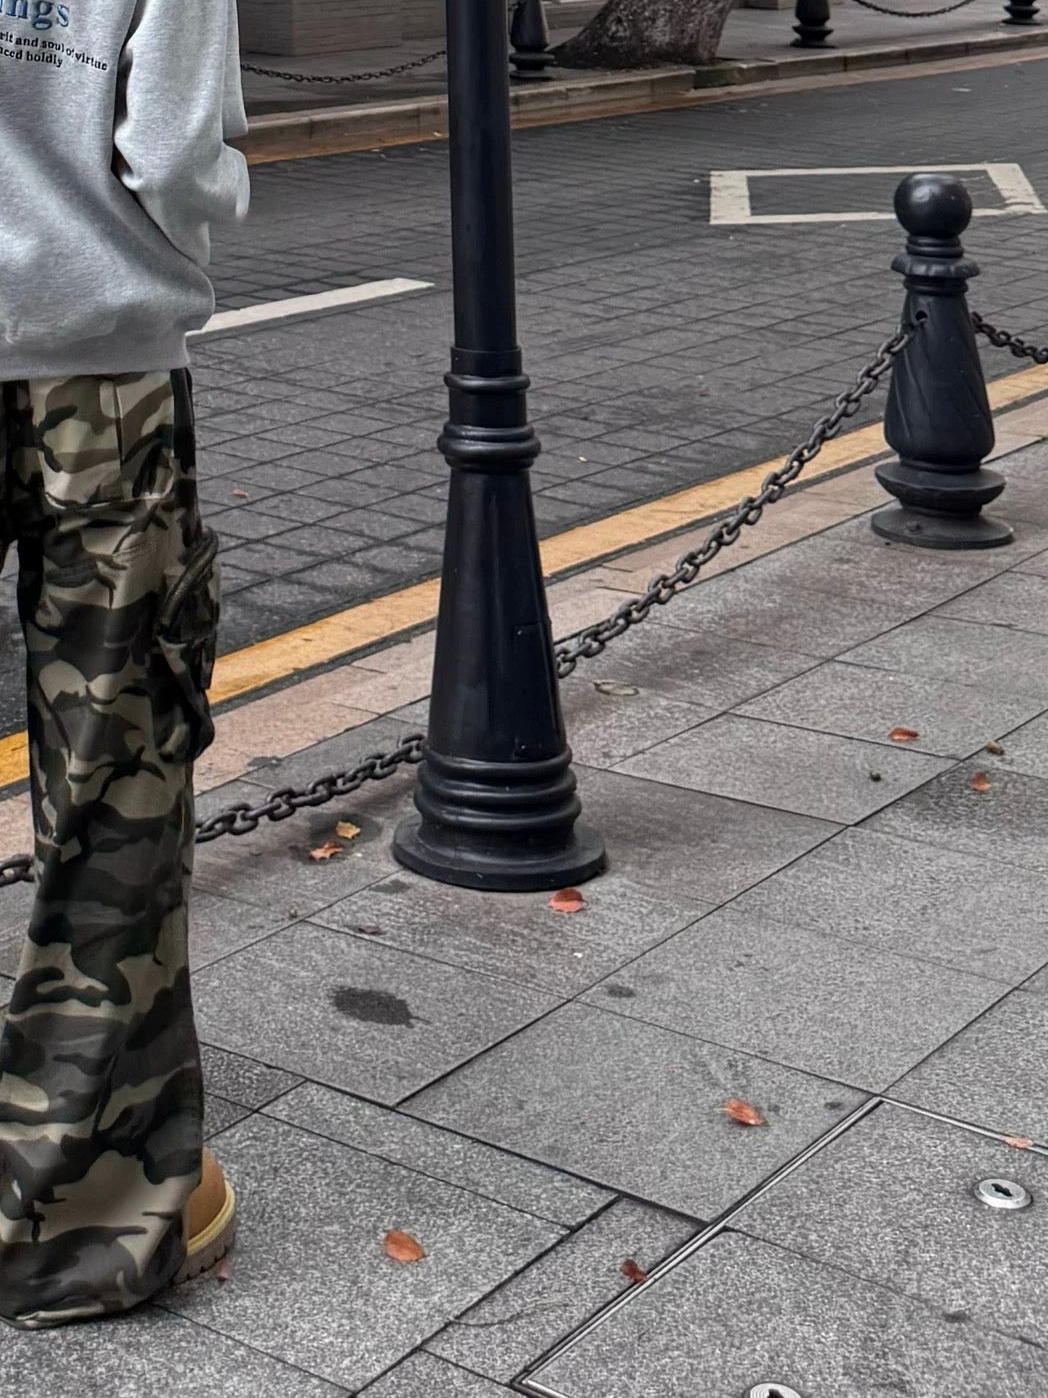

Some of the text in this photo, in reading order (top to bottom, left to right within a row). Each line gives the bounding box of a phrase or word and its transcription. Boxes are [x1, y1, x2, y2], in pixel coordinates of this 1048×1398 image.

[15, 36, 39, 48] and
[41, 40, 65, 53] soul
[75, 52, 108, 71] virtue
[26, 50, 63, 68] boldly
